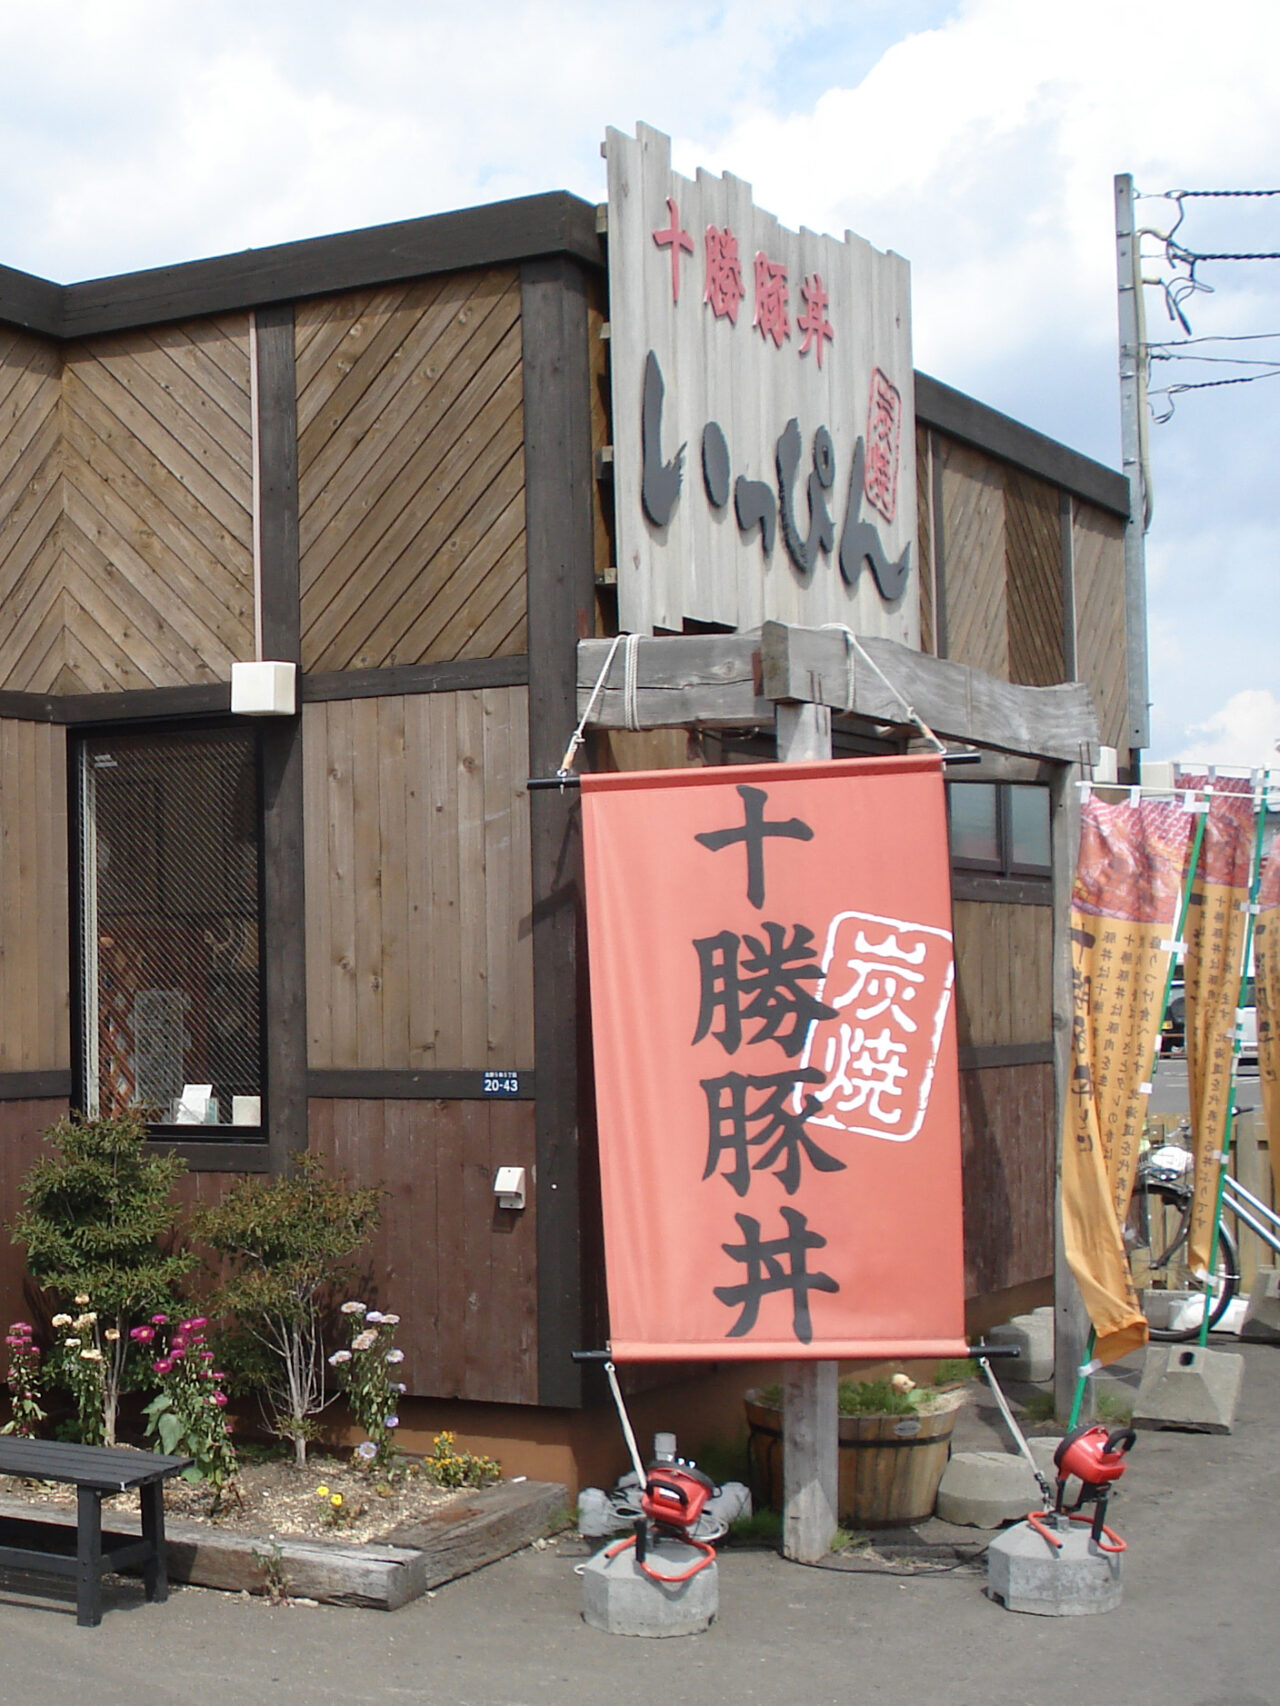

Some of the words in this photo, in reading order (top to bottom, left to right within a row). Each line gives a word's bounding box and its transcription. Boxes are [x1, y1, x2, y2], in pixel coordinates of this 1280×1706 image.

[652, 197, 834, 369] 十勝豚丼
[642, 349, 911, 601] いっぴん
[484, 1079, 518, 1092] 20-43
[691, 784, 848, 1345] 十勝豚丼
[813, 931, 926, 1124] 炭焼
